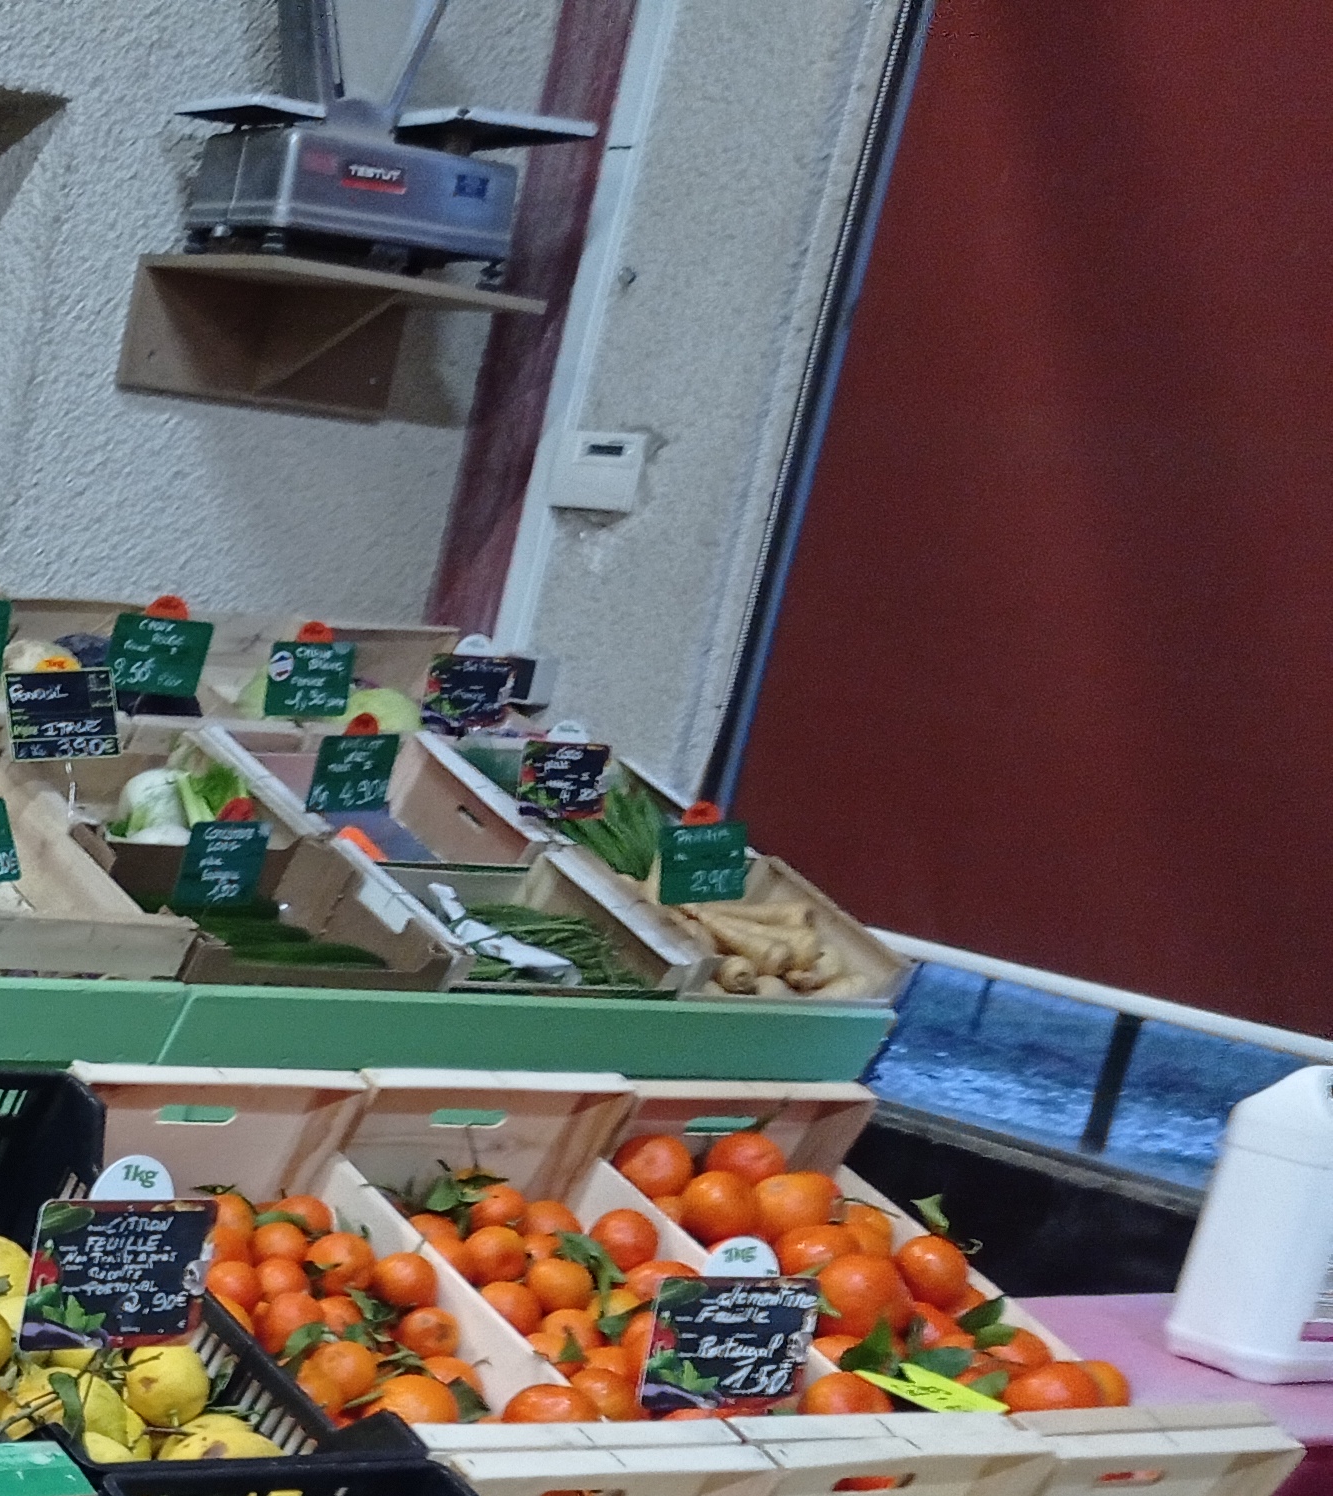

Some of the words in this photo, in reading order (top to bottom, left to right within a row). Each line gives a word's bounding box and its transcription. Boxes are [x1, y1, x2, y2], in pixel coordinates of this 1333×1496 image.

[349, 163, 401, 182] TESTUT
[122, 1164, 159, 1189] 1kg
[722, 1245, 758, 1264] 1kg
